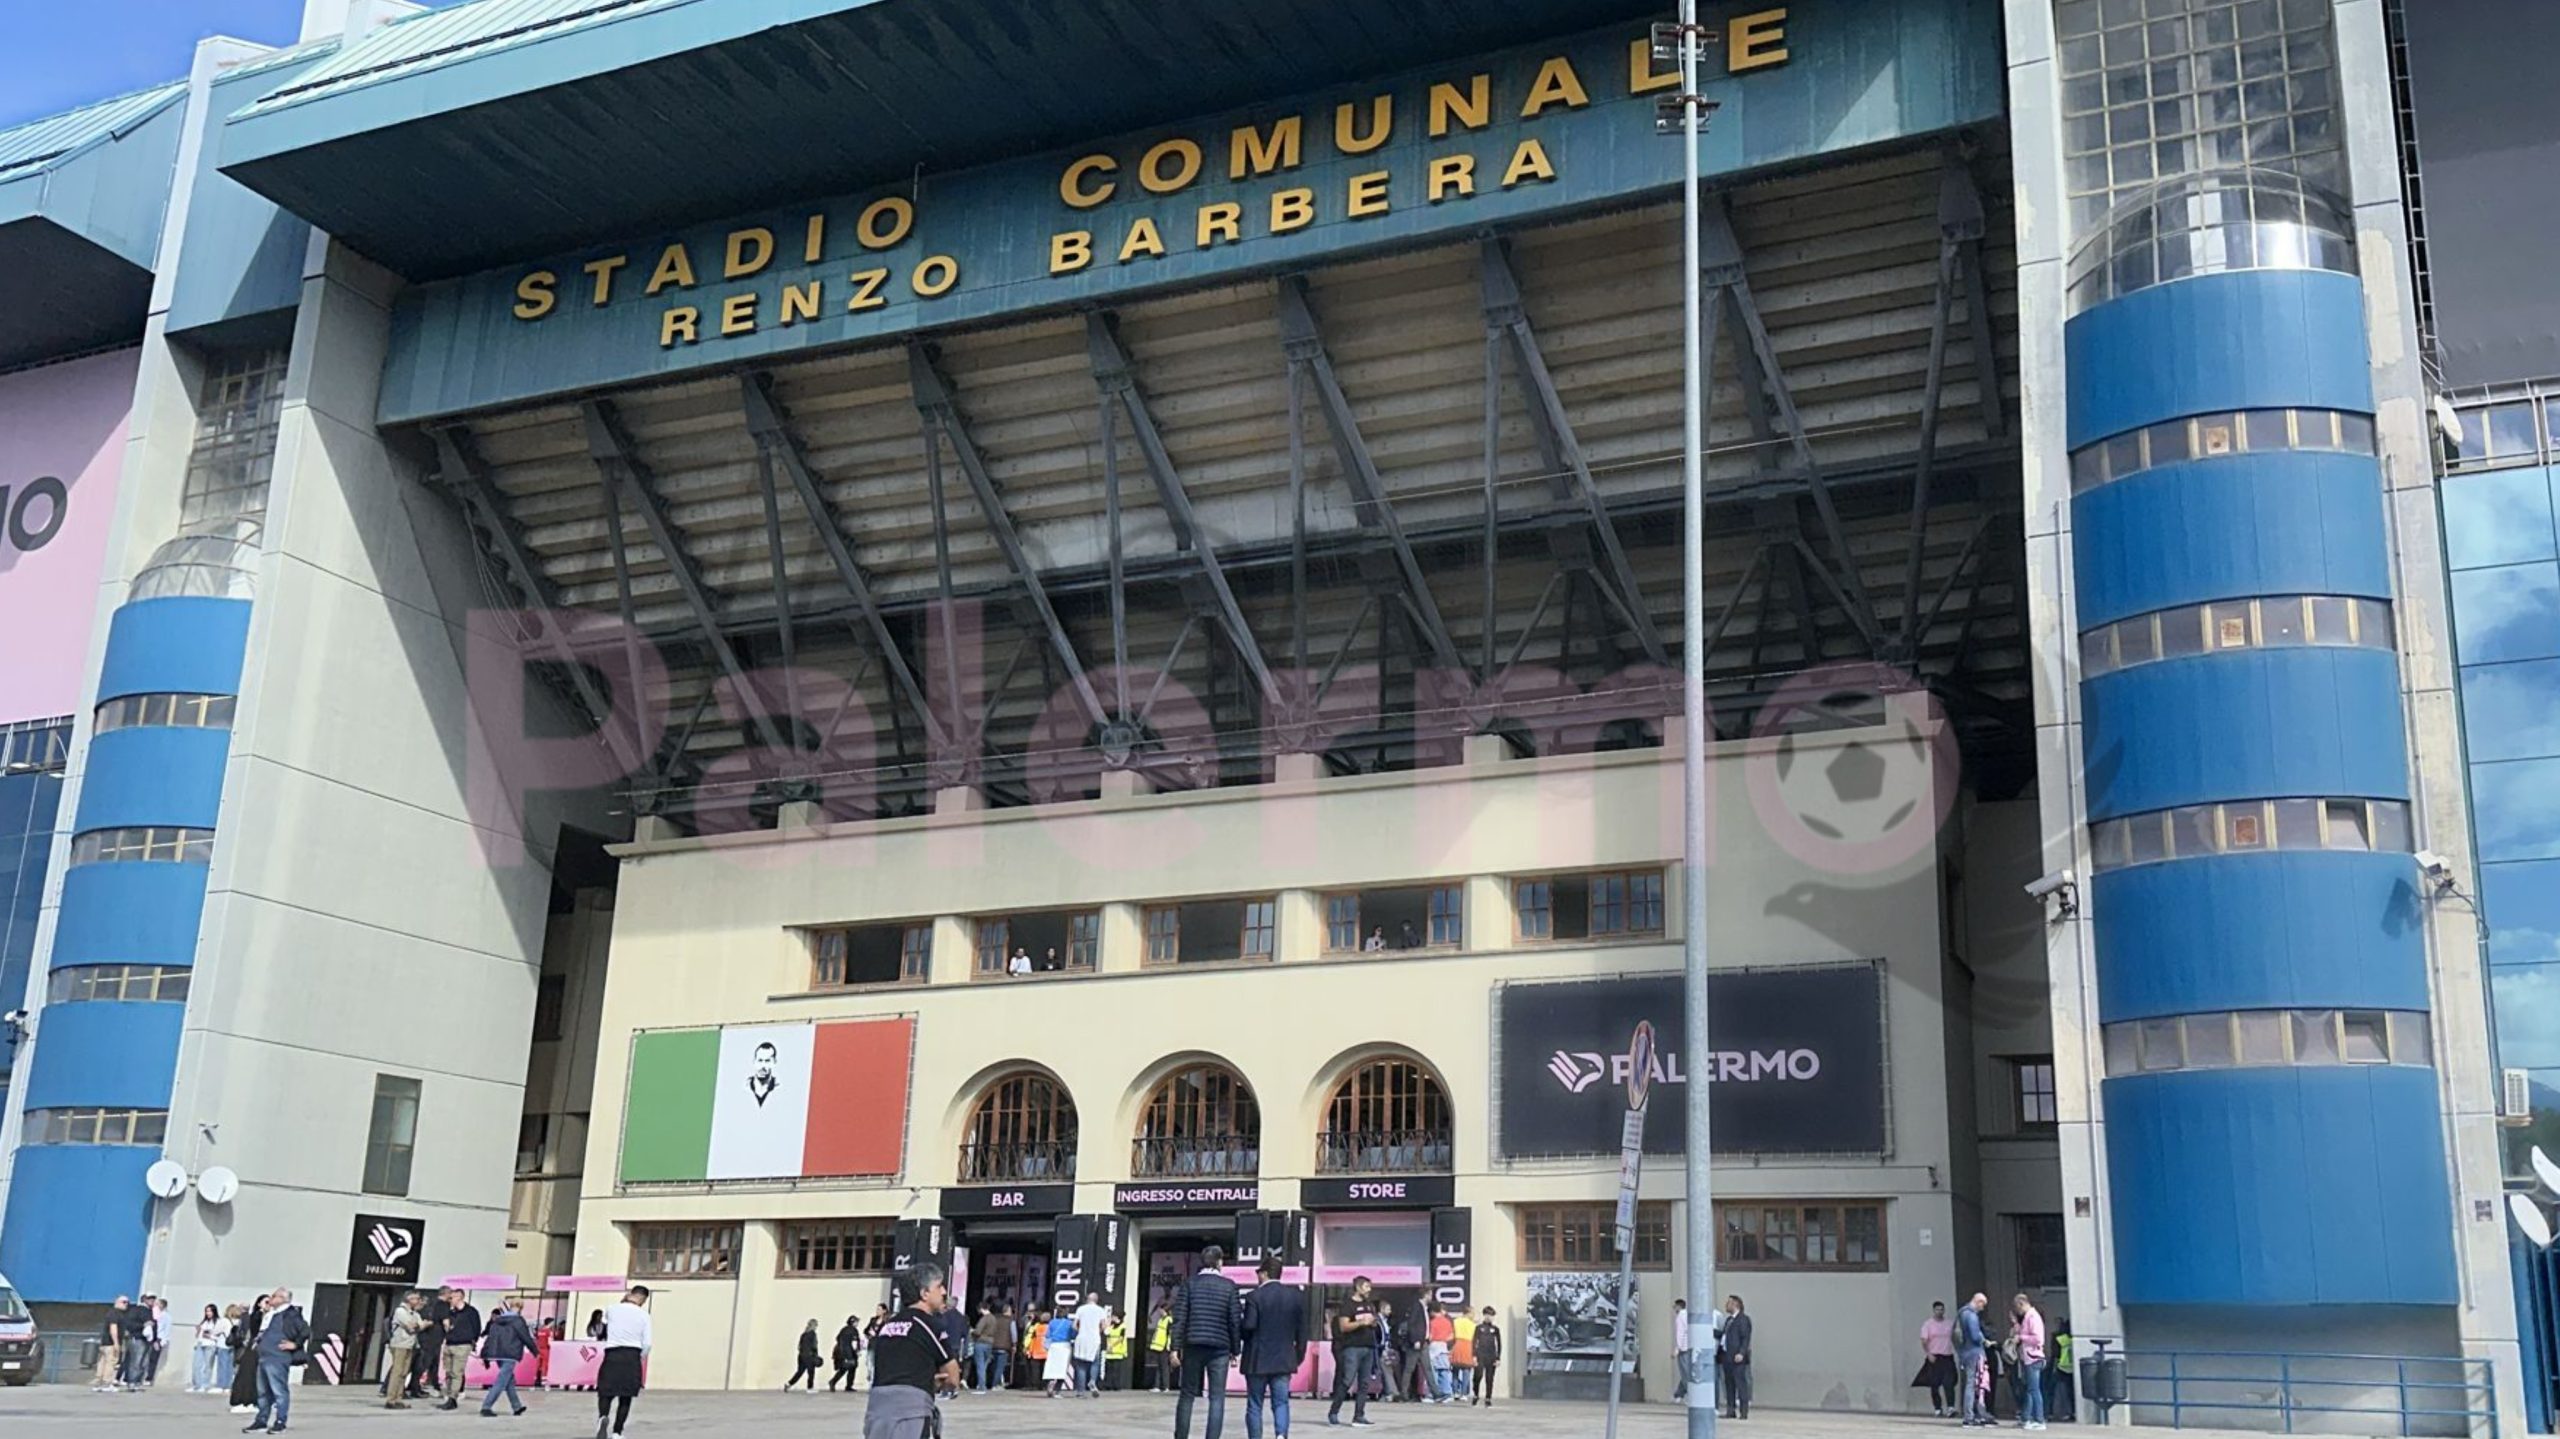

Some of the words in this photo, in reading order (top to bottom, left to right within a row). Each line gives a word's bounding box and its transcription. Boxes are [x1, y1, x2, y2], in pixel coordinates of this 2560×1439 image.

[513, 196, 914, 319] STADIO
[1059, 8, 1789, 208] COMUNALE
[660, 255, 958, 347] RENZO
[1050, 138, 1556, 273] BARBERA
[991, 1192, 1025, 1207] BAR
[1116, 1189, 1185, 1203] INGRESSO
[1186, 1187, 1259, 1201] CENTRALE
[1349, 1182, 1407, 1198] STORE
[1435, 1243, 1465, 1304] ORE
